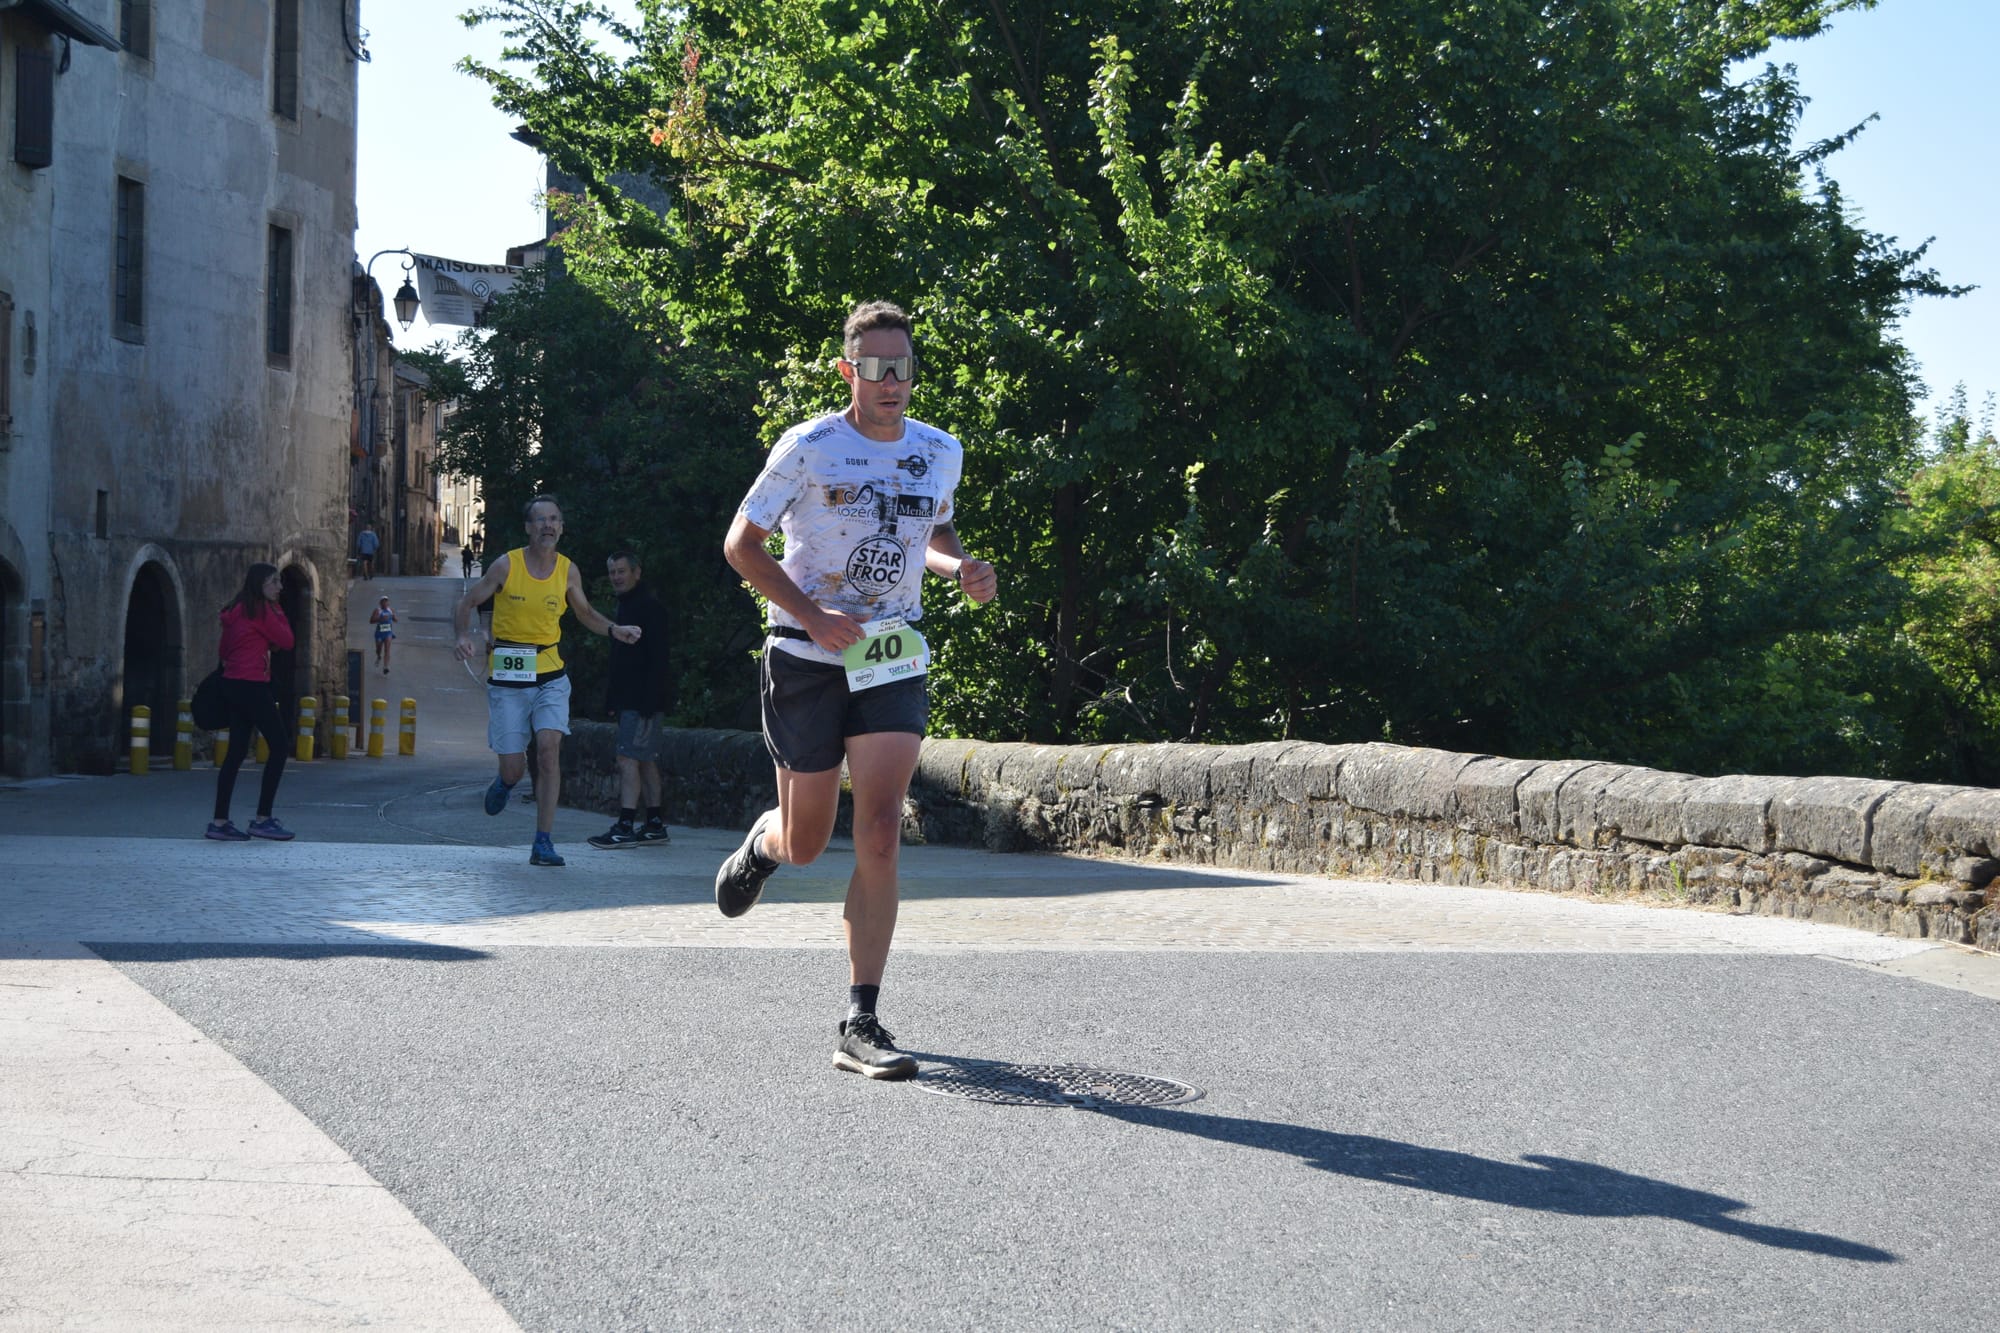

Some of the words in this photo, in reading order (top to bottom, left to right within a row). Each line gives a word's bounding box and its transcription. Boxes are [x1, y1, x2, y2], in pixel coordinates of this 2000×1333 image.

[420, 258, 488, 273] MAISON
[899, 504, 933, 517] Mende
[856, 548, 902, 568] STAR
[852, 563, 900, 584] TROC
[864, 634, 903, 663] 40
[503, 656, 525, 670] 98
